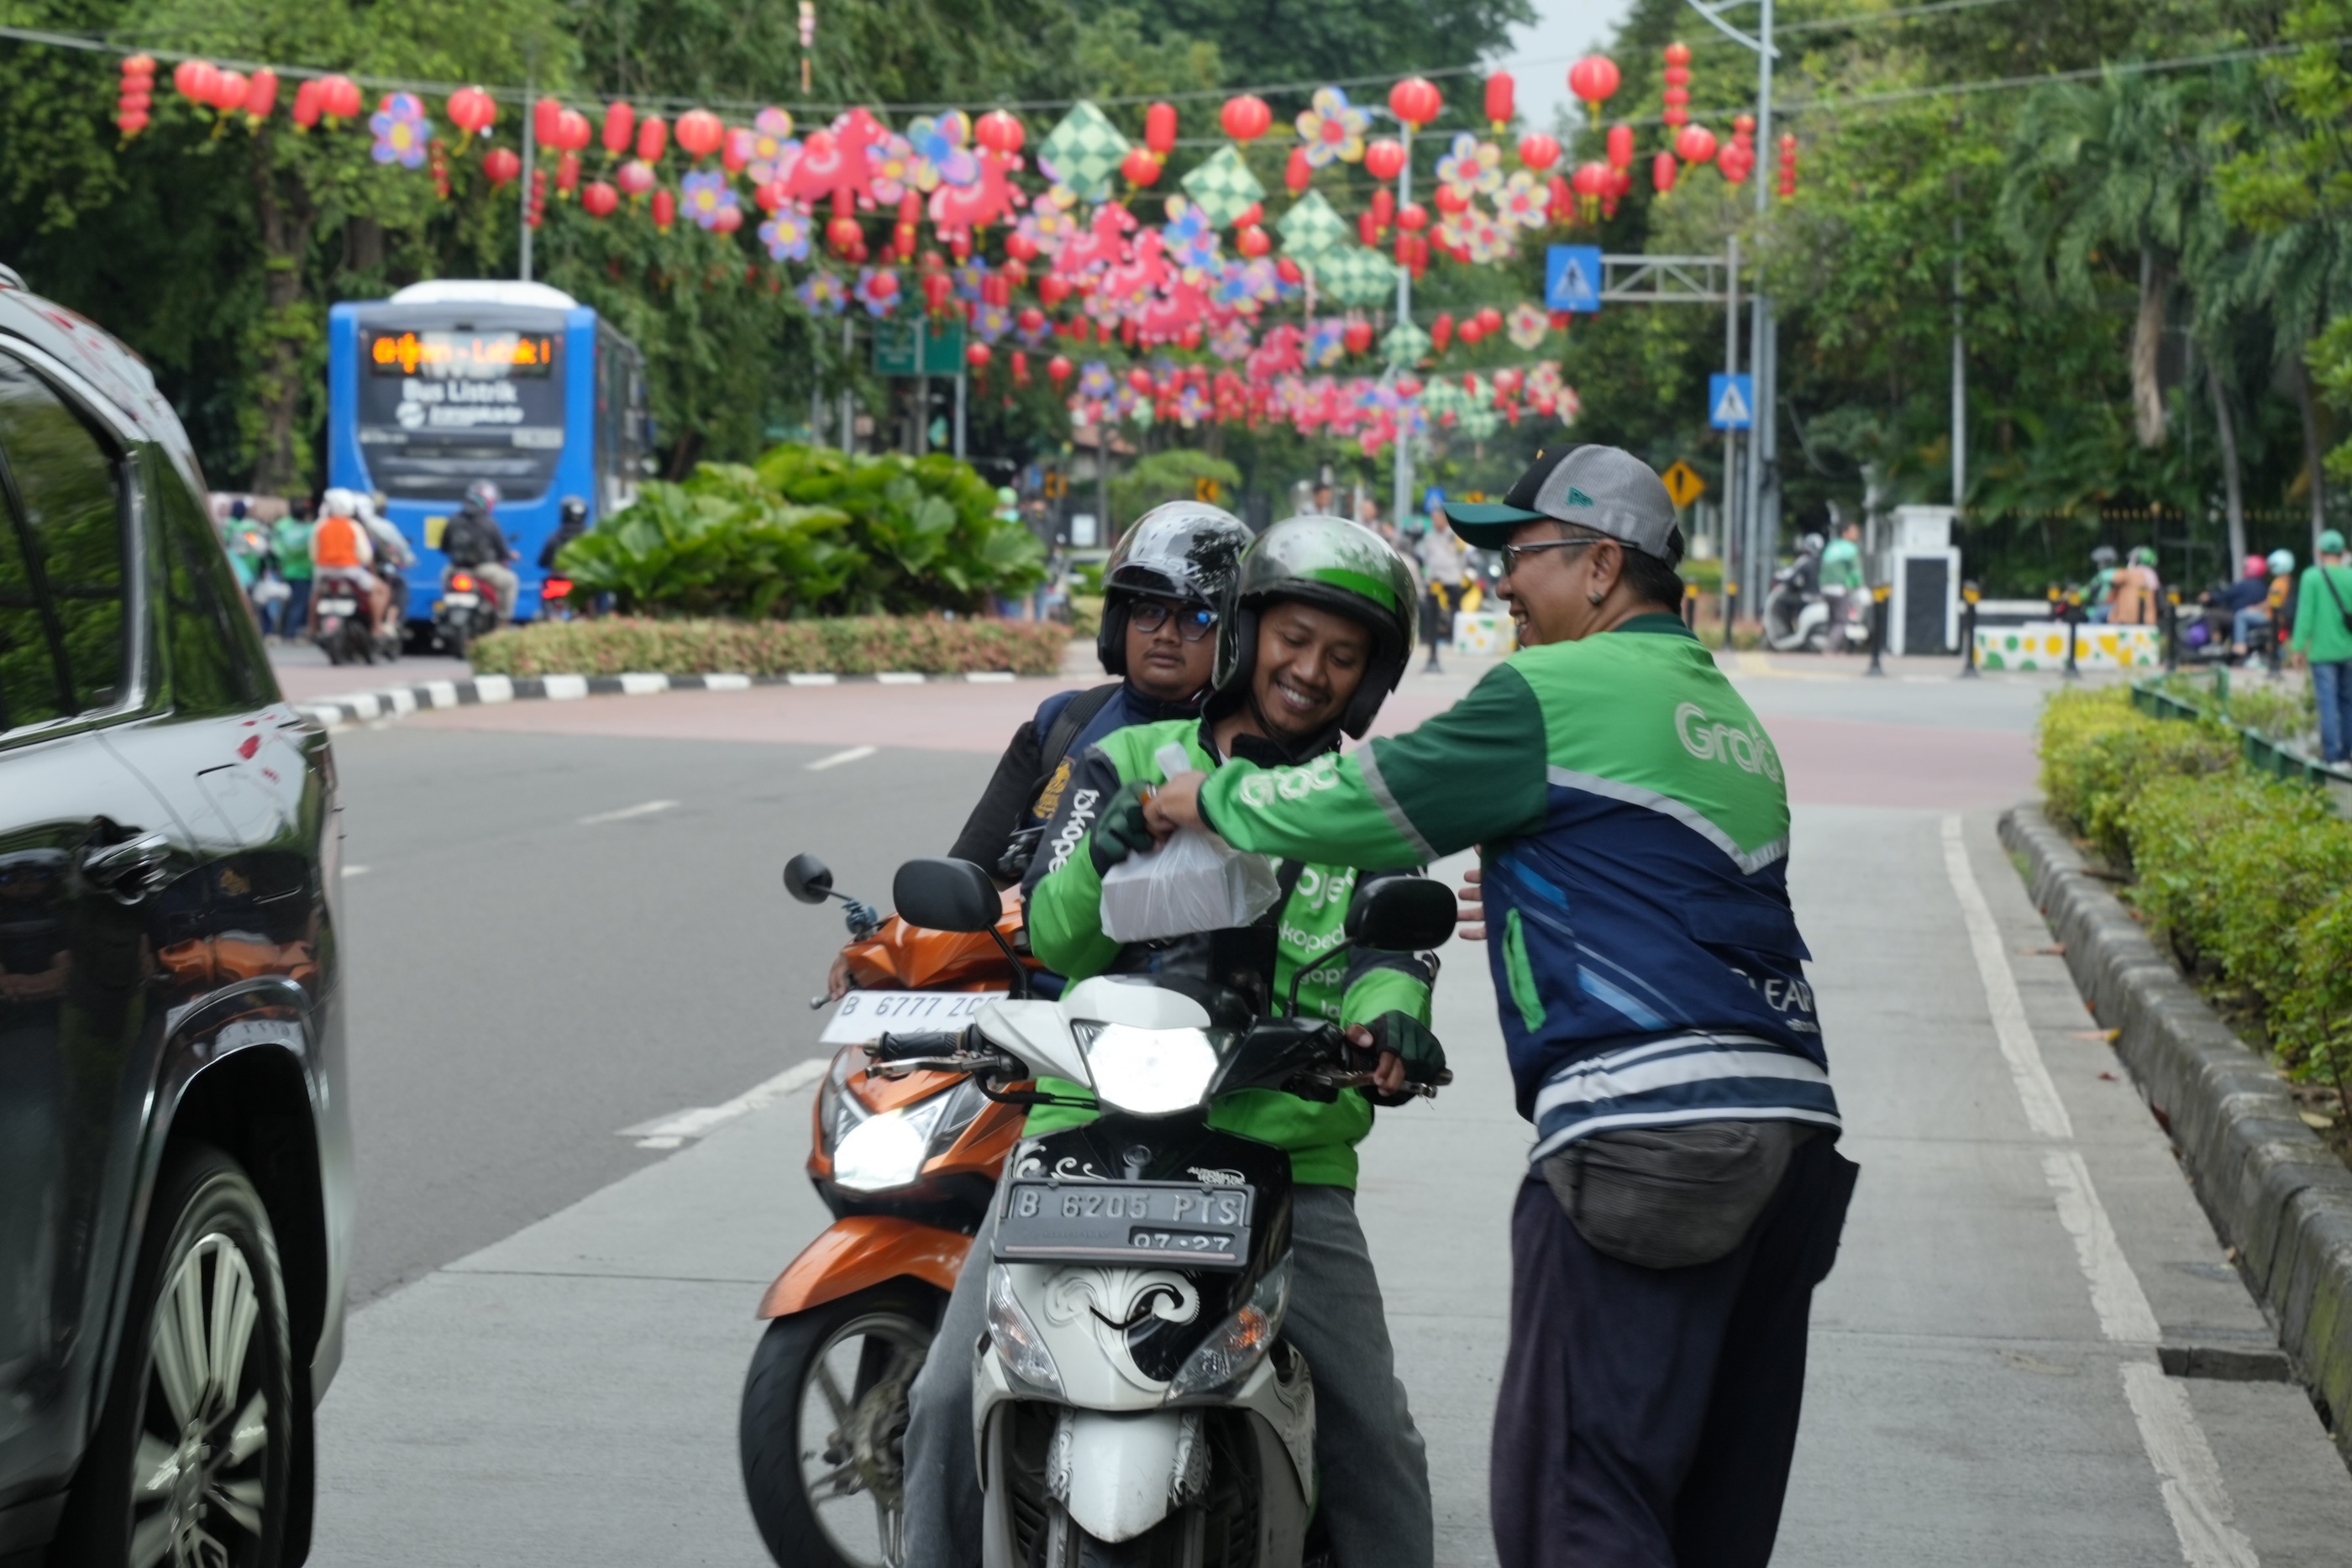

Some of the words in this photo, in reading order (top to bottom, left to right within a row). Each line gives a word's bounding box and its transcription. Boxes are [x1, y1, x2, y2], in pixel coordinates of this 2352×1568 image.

[402, 378, 445, 402] Bus
[842, 995, 860, 1016] B
[875, 996, 942, 1017] 6777
[1019, 1190, 1040, 1218] B
[1062, 1193, 1148, 1219] 6205
[1172, 1194, 1238, 1225] PTS
